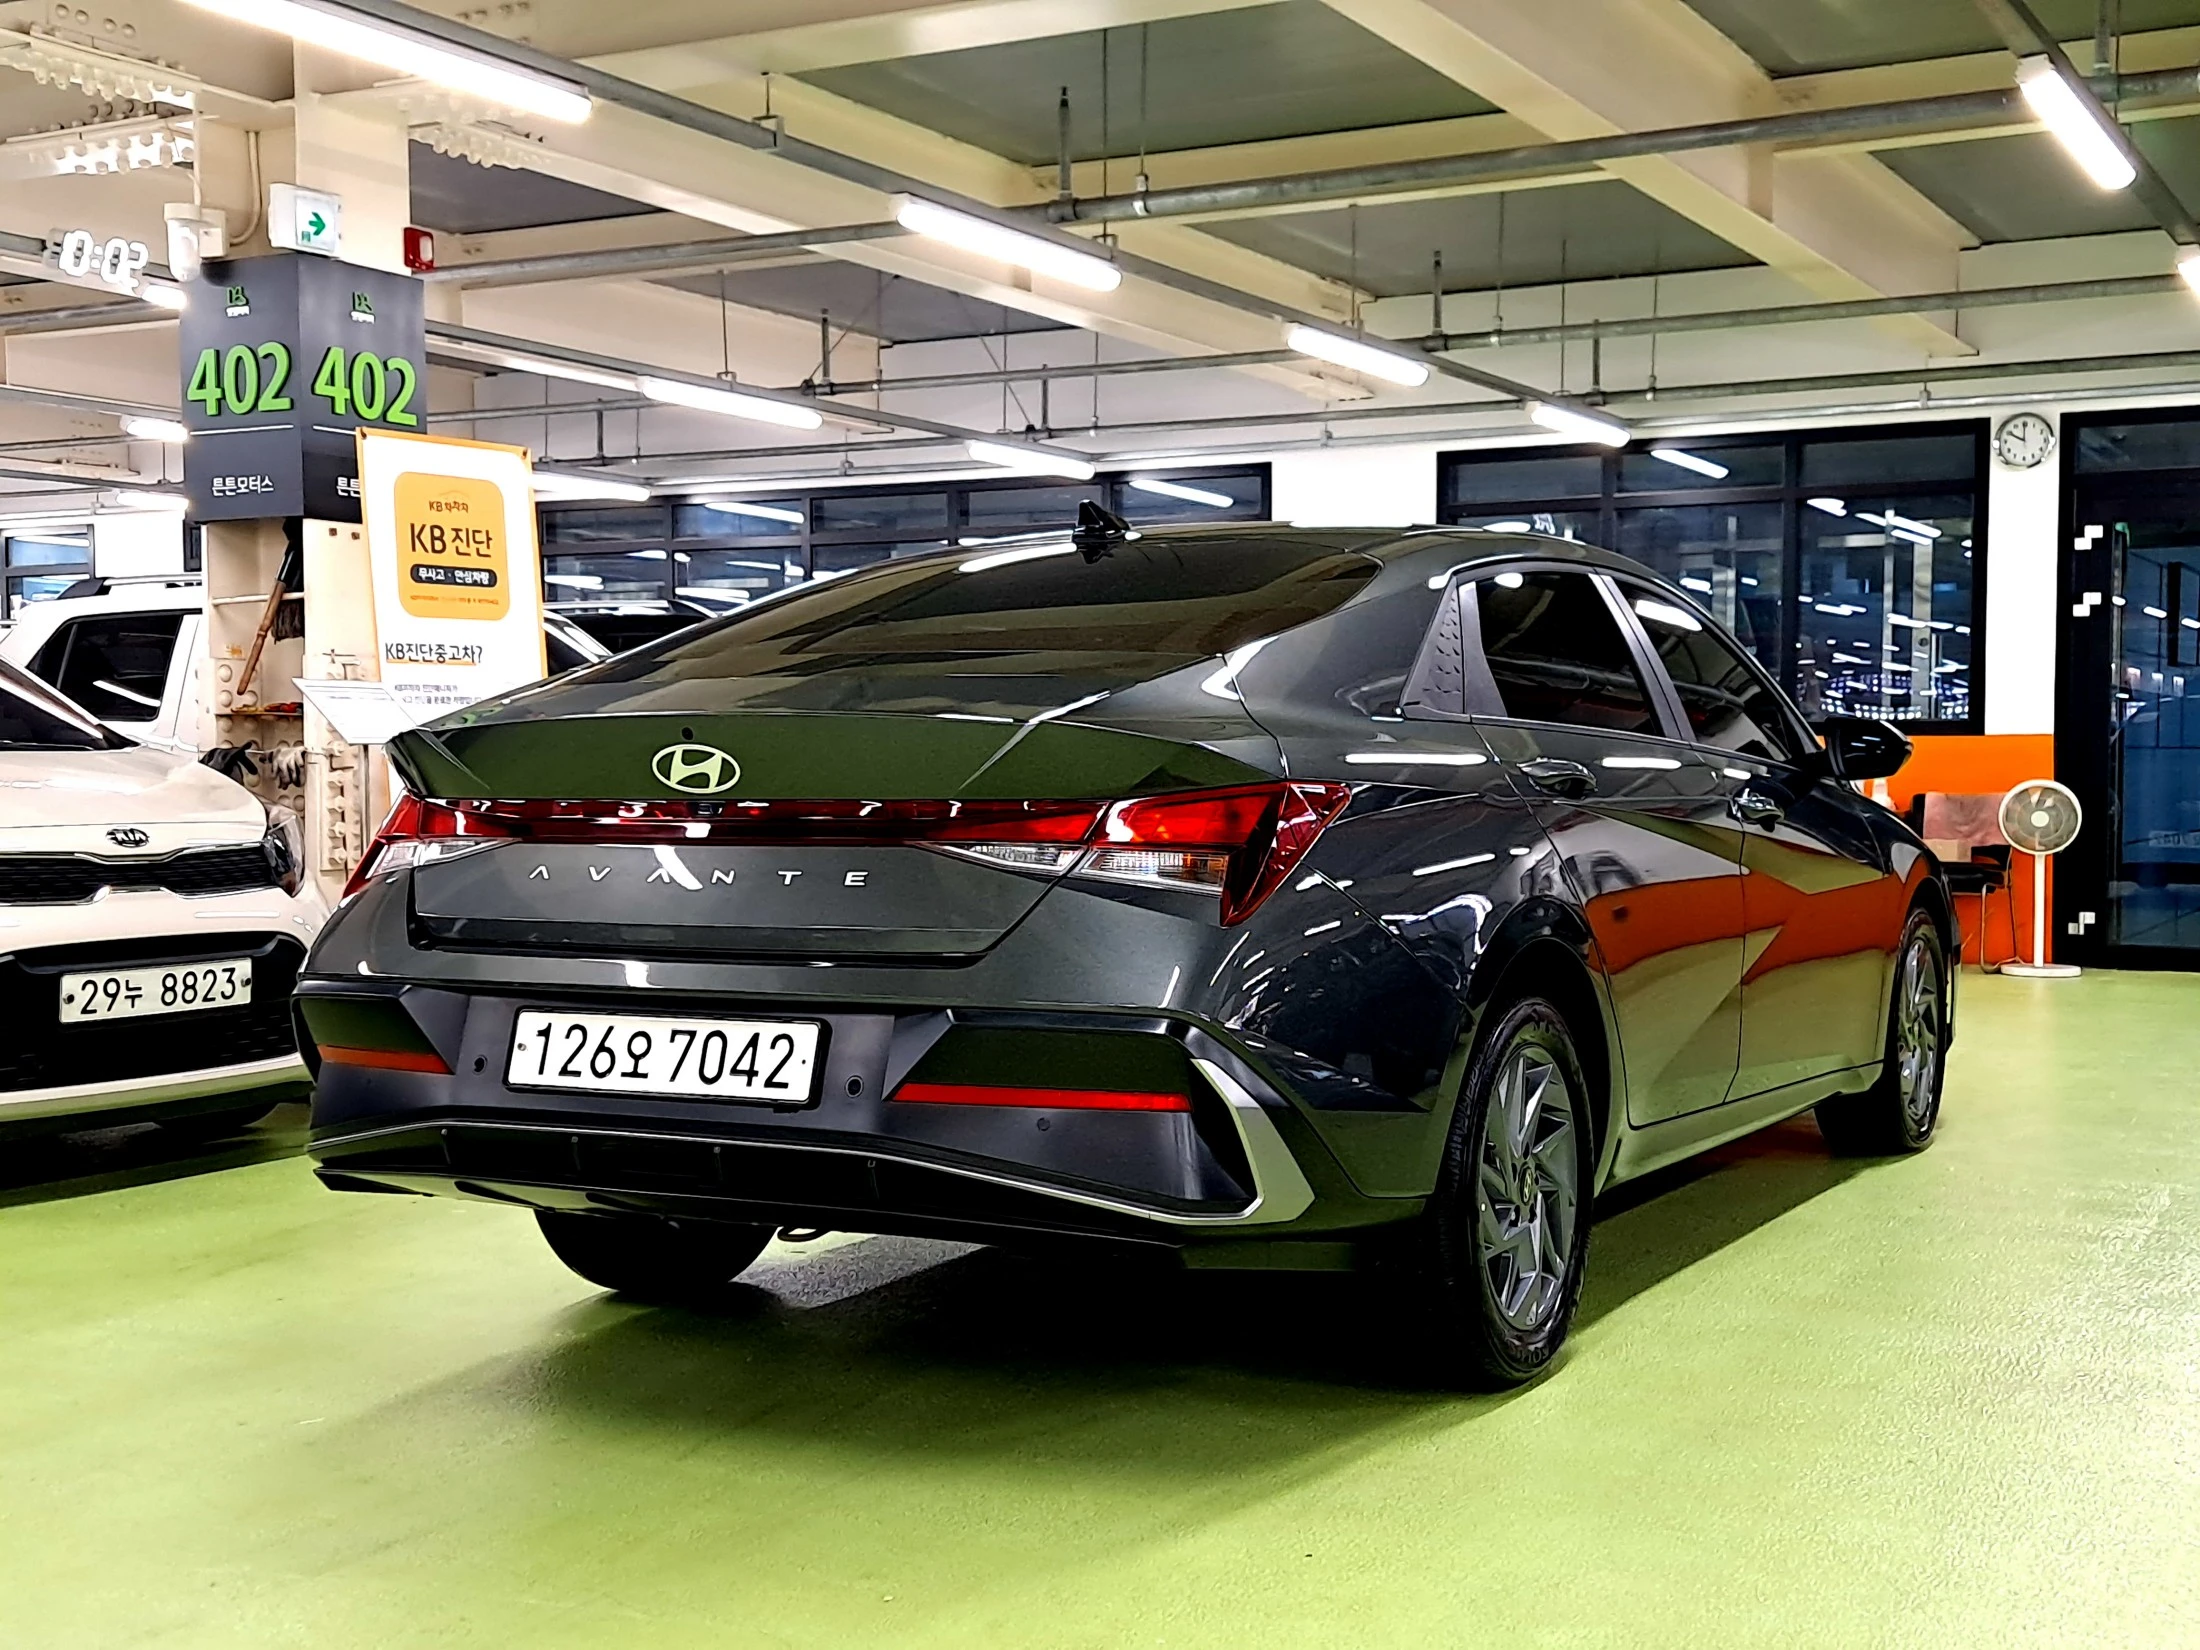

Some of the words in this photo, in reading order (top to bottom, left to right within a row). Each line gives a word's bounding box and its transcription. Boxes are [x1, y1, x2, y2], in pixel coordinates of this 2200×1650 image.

[186, 341, 293, 416] 402
[311, 346, 418, 427] 402
[211, 474, 275, 497] 튼튼모터스
[410, 522, 447, 555] KB
[450, 527, 493, 558] 진단
[385, 642, 483, 664] KB진단중고차?
[529, 864, 869, 888] AVANTE
[80, 977, 144, 1015] 29누
[160, 966, 237, 1007] 8823
[536, 1022, 653, 1079] 126오
[669, 1027, 796, 1090] 7042
